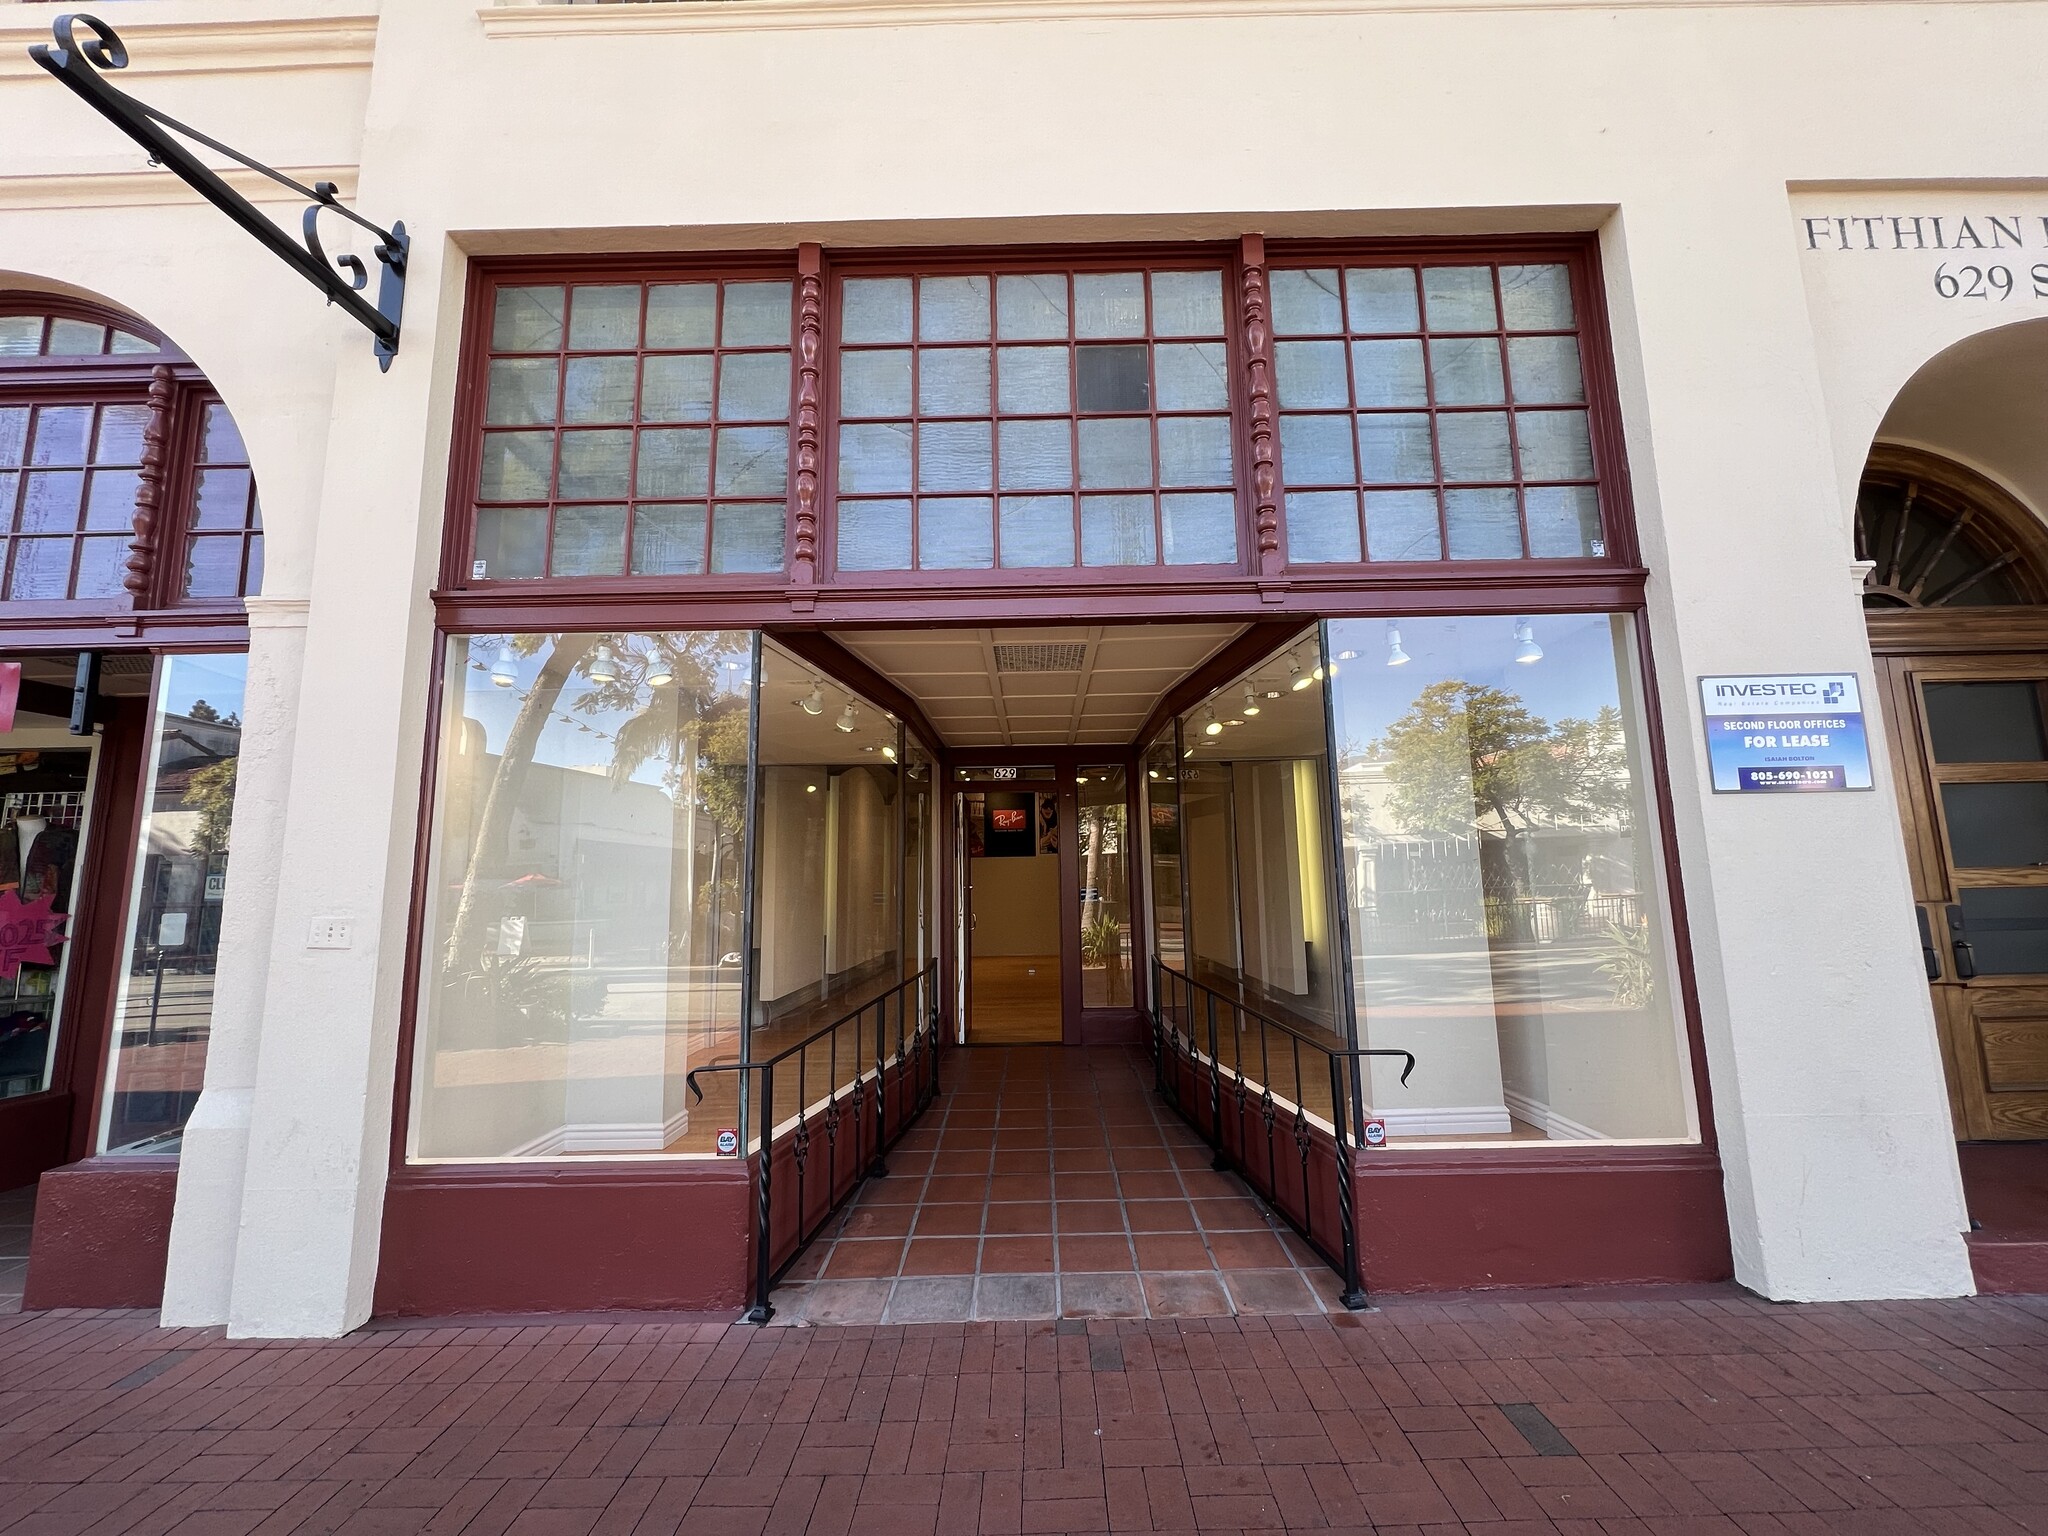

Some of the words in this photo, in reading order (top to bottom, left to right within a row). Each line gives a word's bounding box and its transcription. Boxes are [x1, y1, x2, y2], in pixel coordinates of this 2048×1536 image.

[1801, 214, 2023, 250] FITHIAN
[1934, 262, 2013, 301] 629
[1724, 721, 1765, 731] SECOND
[1768, 720, 1801, 730] FLOOR
[1803, 719, 1846, 729] OFFICES
[1744, 735, 1777, 748] FOR
[1782, 734, 1830, 748] LEASE
[994, 768, 1016, 778] 629
[1750, 771, 1834, 780] 805-690-1021
[994, 811, 1024, 827] Ray-Ban
